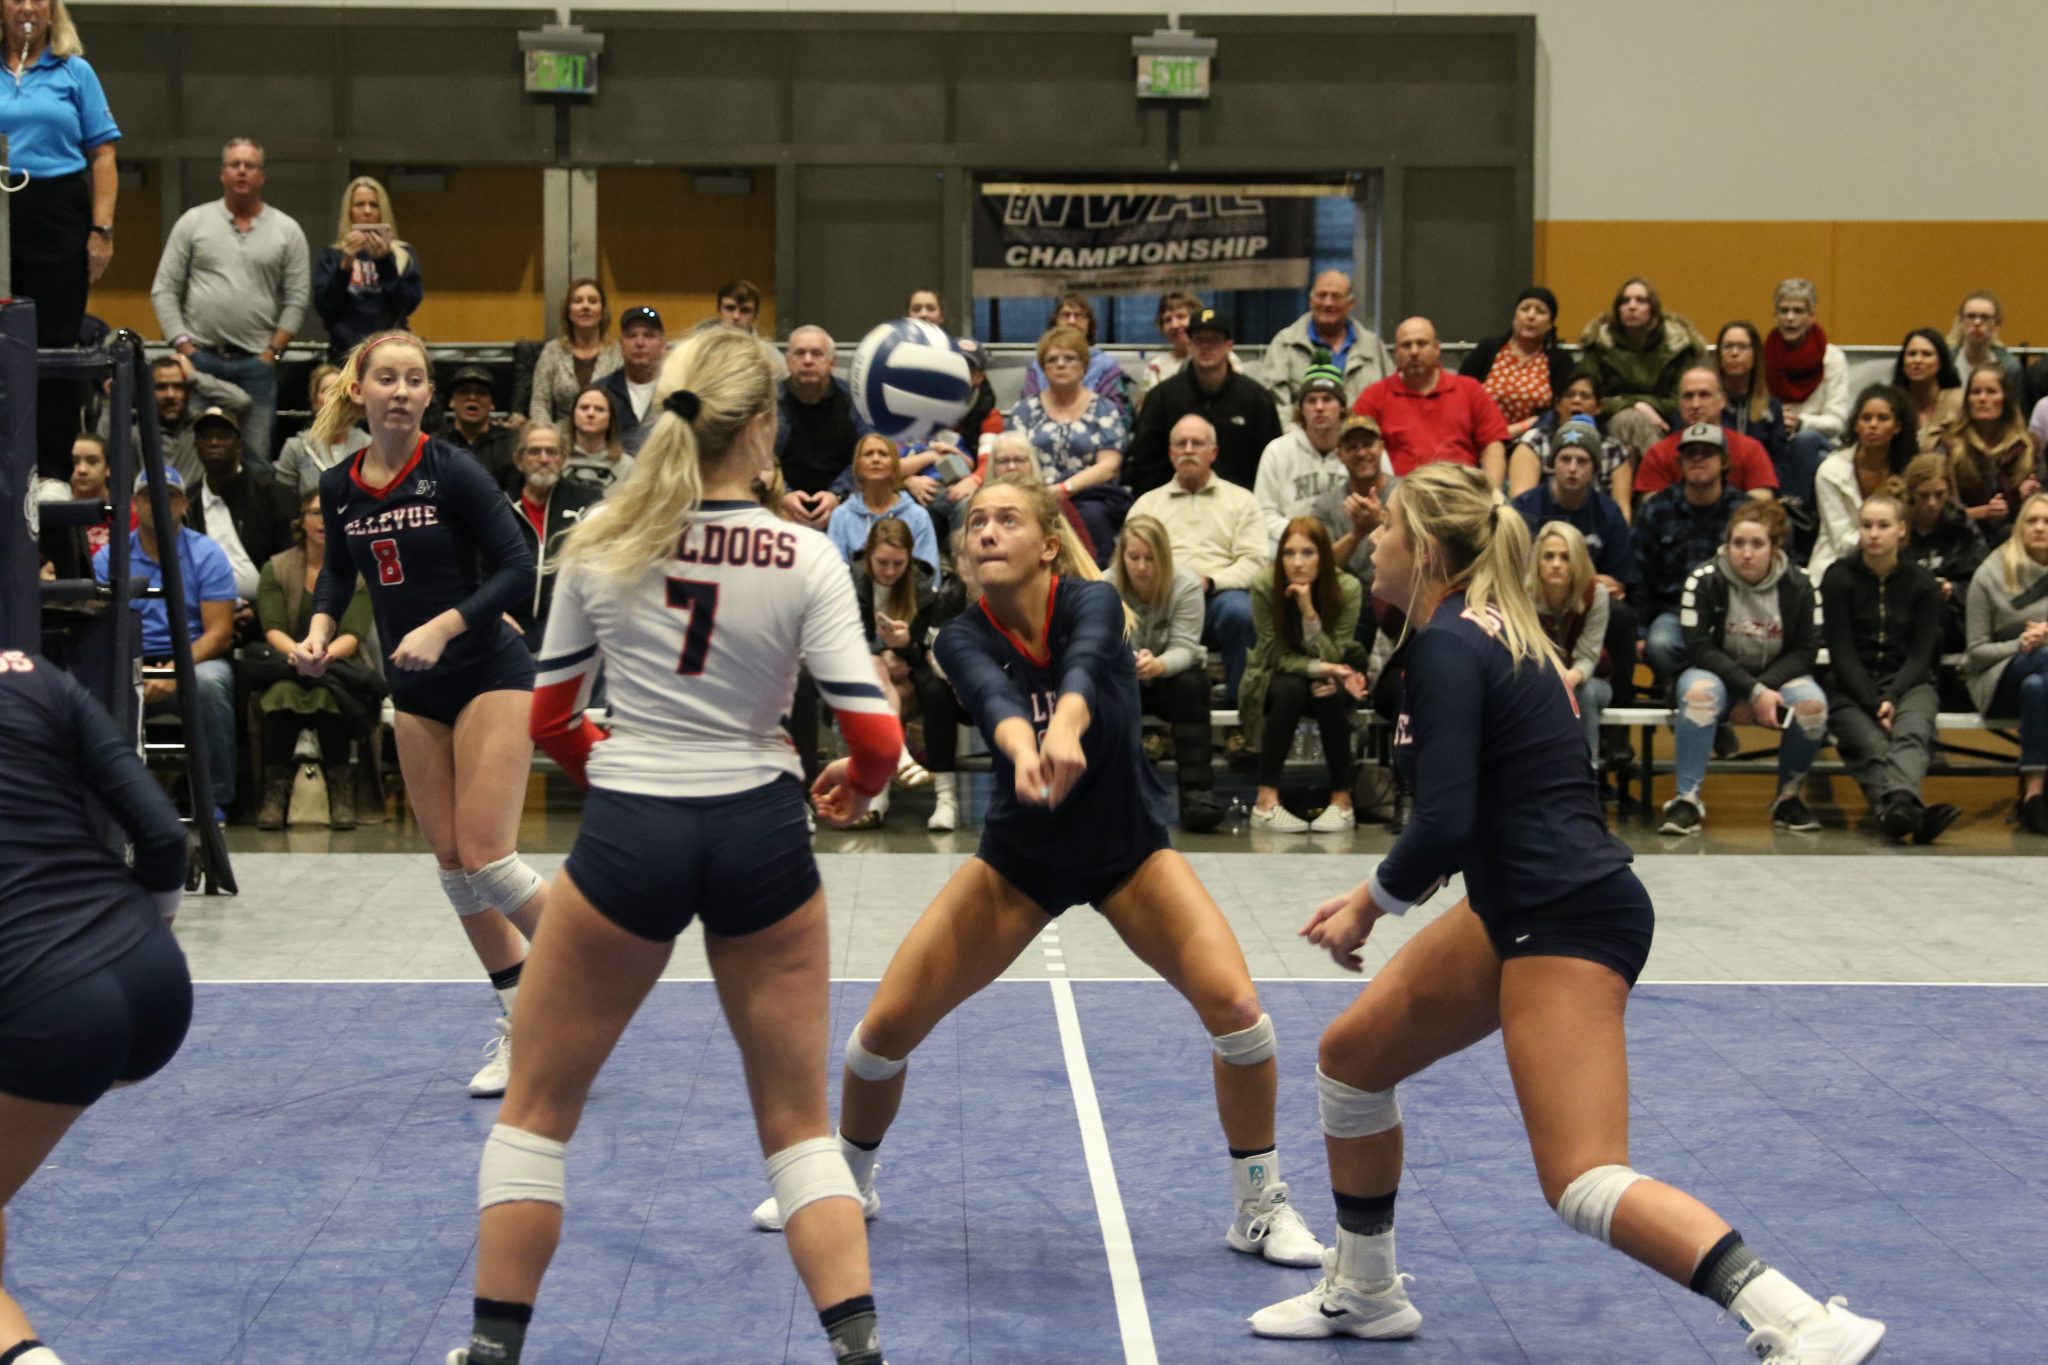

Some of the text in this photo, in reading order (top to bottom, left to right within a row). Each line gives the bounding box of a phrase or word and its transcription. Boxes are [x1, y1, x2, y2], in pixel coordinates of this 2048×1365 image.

[1150, 59, 1199, 93] EXIT
[1005, 235, 1269, 268] CHAMPIONSHIP
[1201, 309, 1215, 323] P
[370, 538, 405, 586] 8
[675, 524, 798, 570] LDOGS
[665, 575, 720, 677] 7
